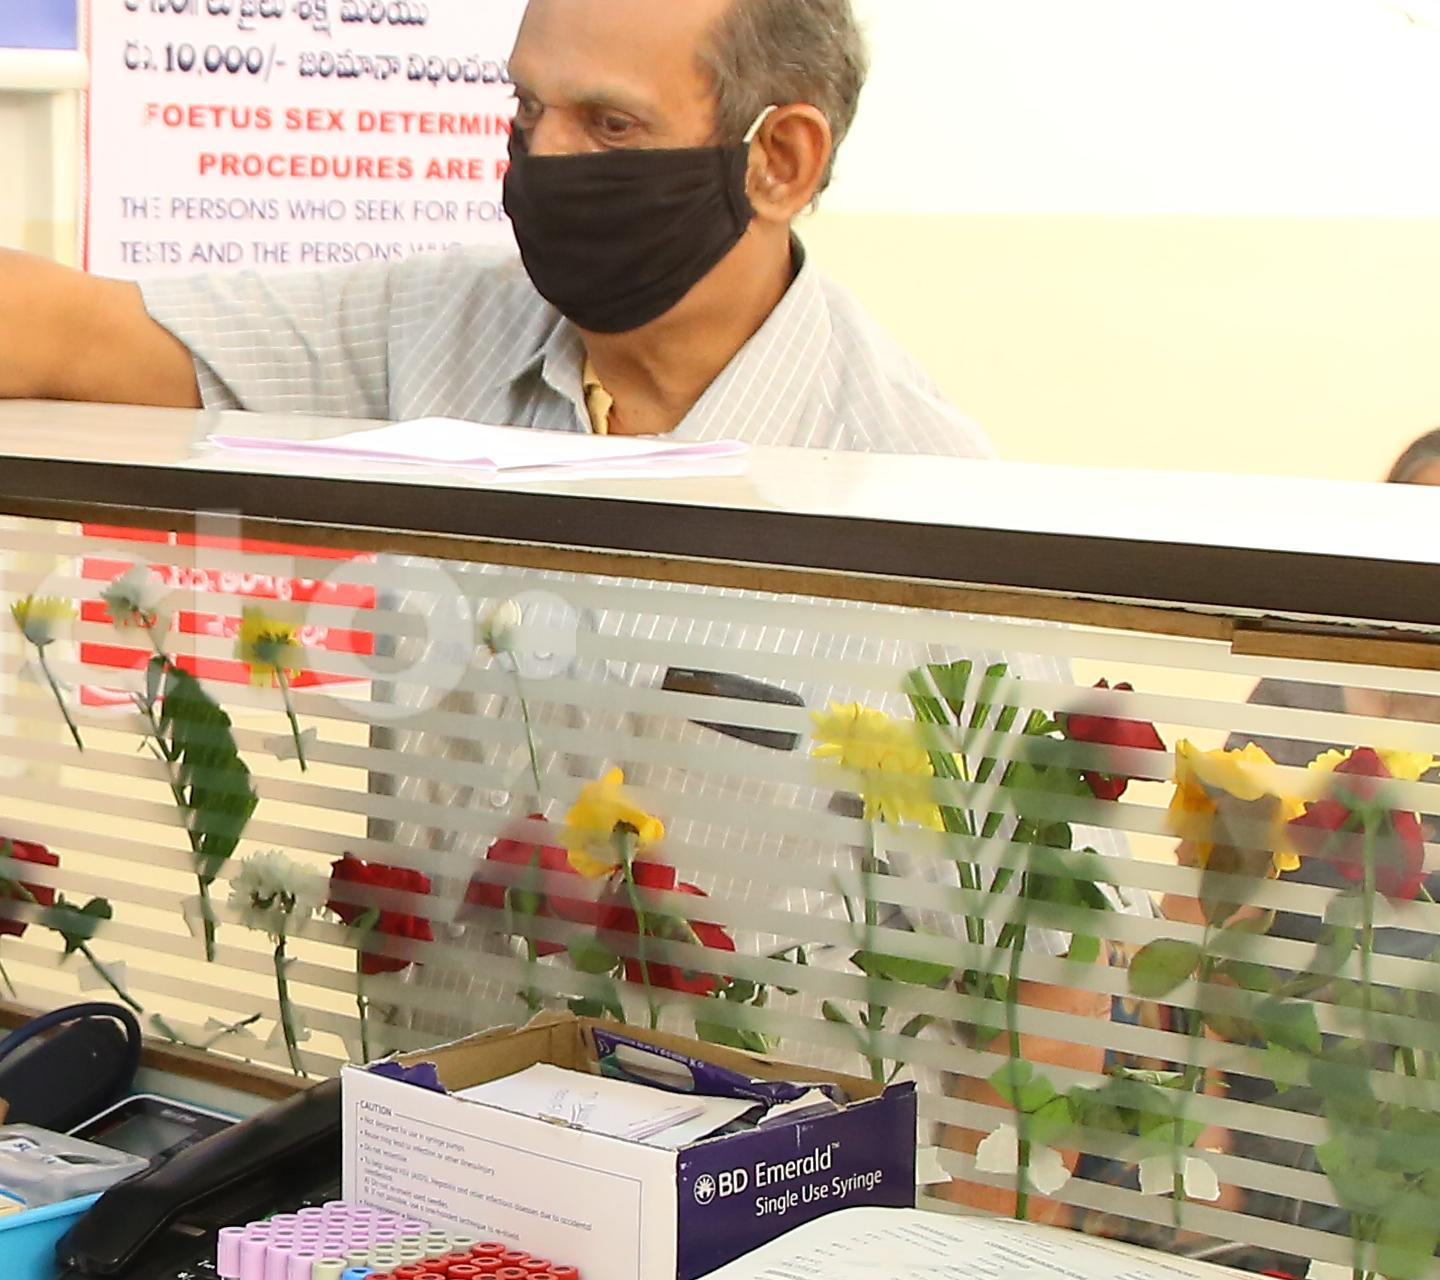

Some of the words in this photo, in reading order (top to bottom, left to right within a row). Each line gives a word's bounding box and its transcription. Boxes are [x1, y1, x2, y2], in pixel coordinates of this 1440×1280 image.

[144, 102, 272, 130] FOETUS
[286, 105, 346, 132] SEX
[198, 153, 413, 180] PROCEDURES
[424, 157, 483, 180] ARE
[171, 197, 279, 221] PERSONS
[288, 197, 346, 221] WHO
[355, 199, 405, 221] SEEK
[414, 200, 458, 221] FOR
[191, 241, 243, 263] AND
[252, 241, 291, 263] THE
[360, 1100, 393, 1116] CAUTION
[718, 1169, 748, 1197] BD
[755, 1190, 799, 1217] Single
[802, 1183, 829, 1204] Use
[832, 1170, 882, 1199] Syringe
